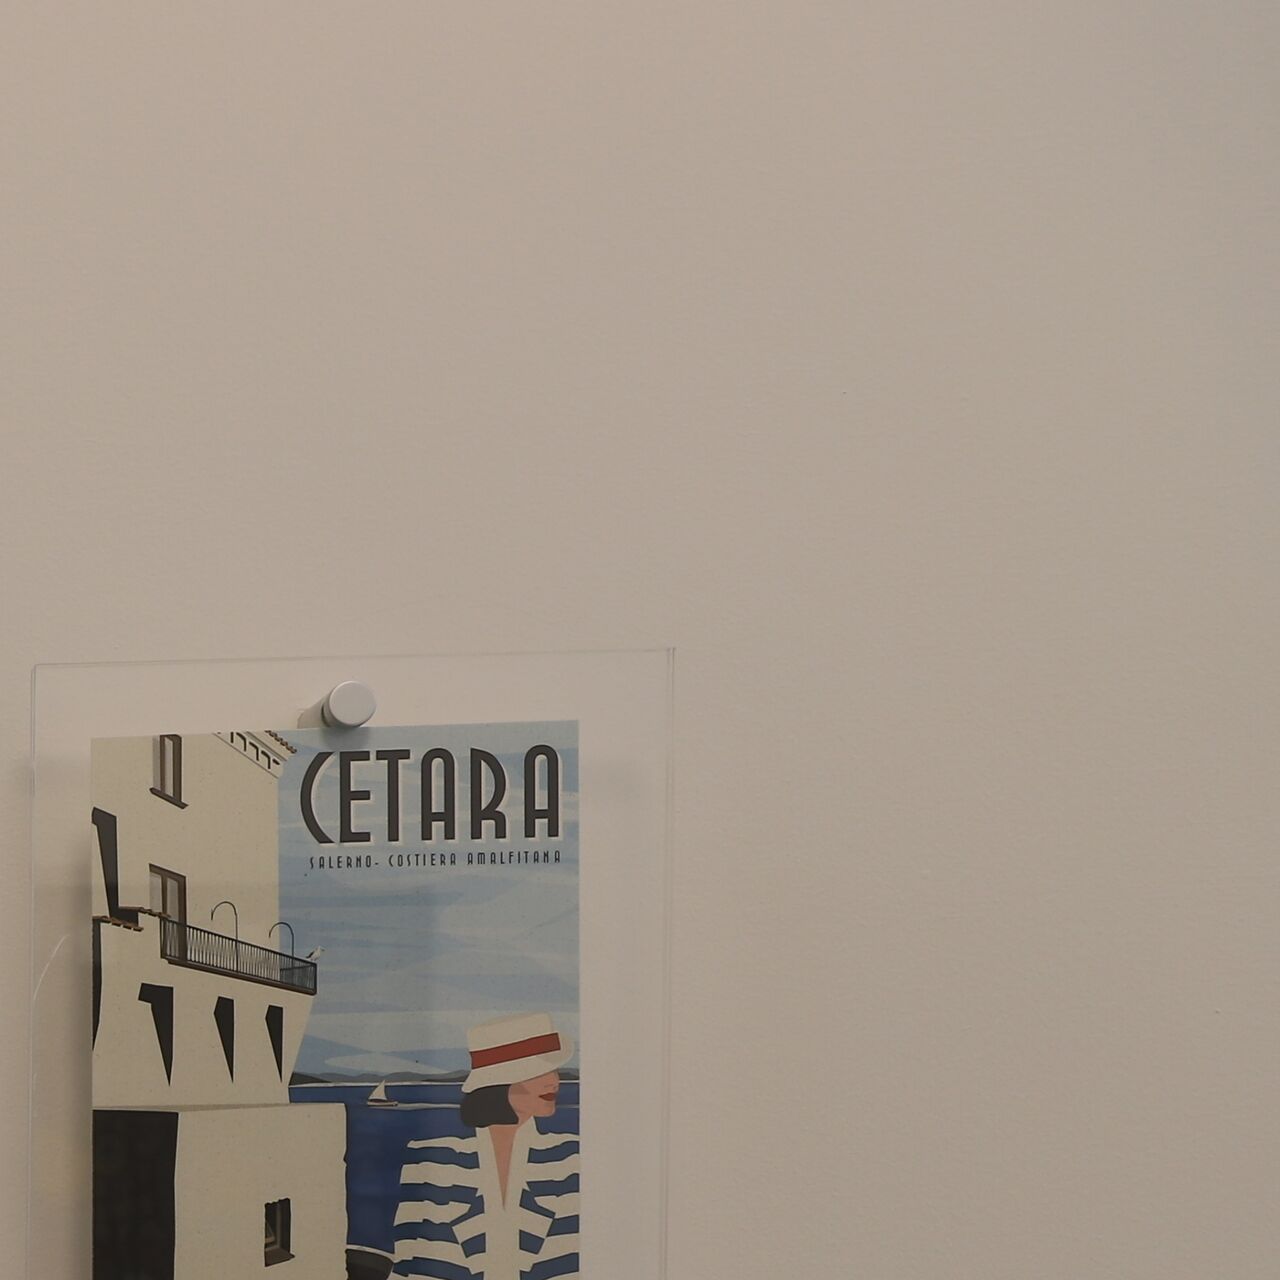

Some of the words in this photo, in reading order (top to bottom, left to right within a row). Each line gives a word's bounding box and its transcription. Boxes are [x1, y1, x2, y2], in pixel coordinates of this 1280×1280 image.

[299, 744, 561, 845] CETARA
[388, 852, 457, 868] COSTIERA
[466, 849, 562, 866] AMALFITANA
